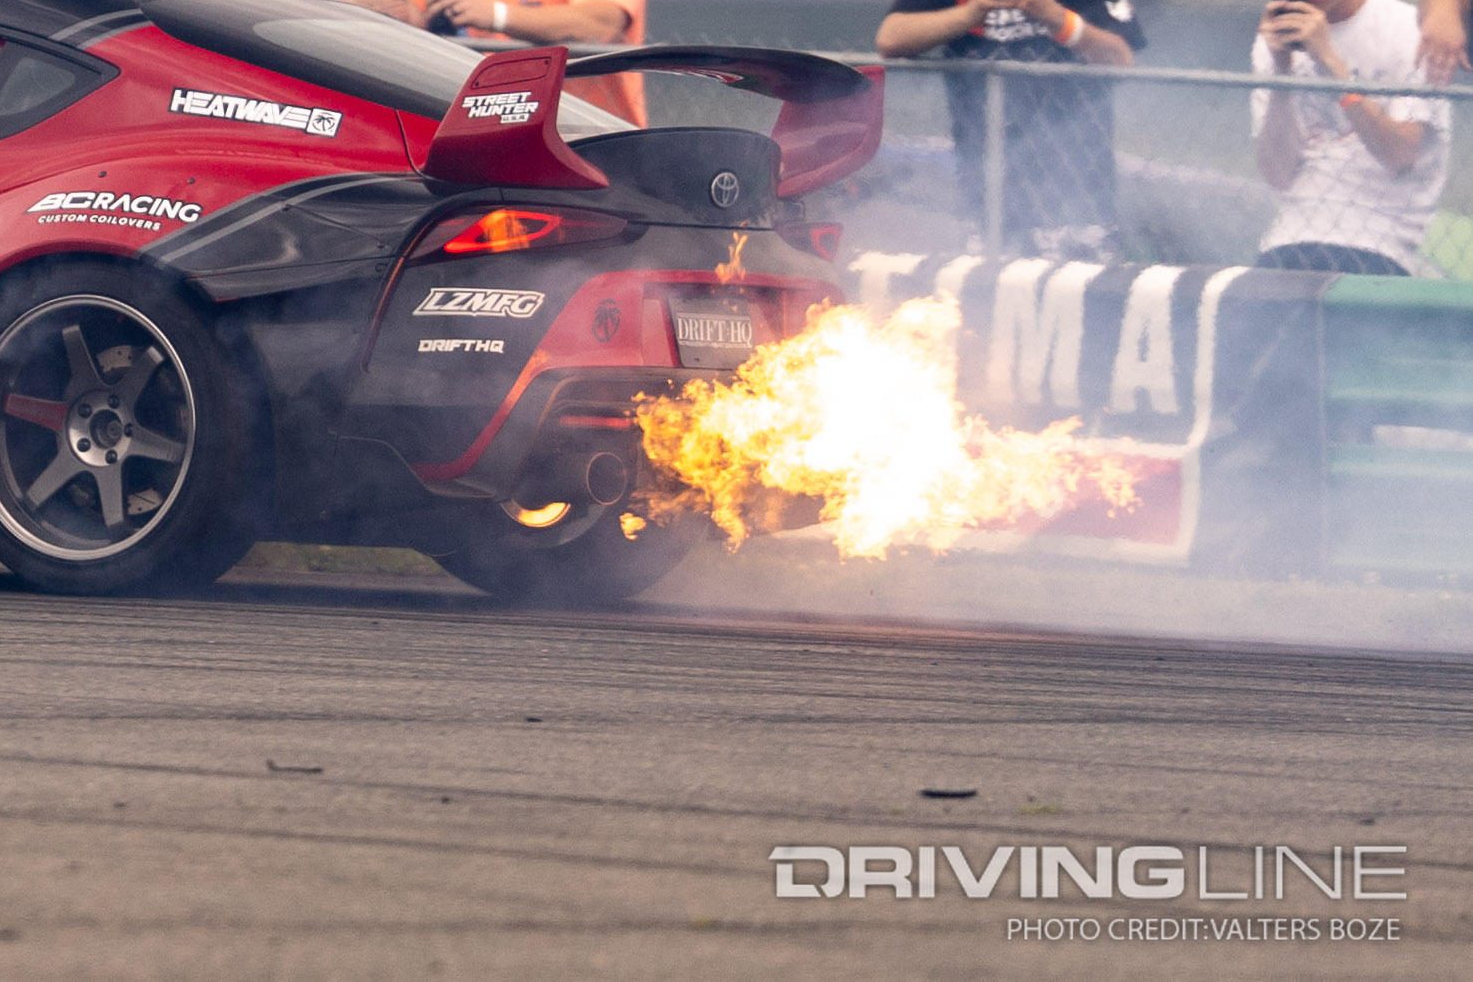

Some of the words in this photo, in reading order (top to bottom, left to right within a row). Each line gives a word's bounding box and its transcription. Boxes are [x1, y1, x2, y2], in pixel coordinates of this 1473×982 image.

[462, 91, 532, 108] STREET
[170, 89, 311, 130] HEATWAVE
[468, 101, 539, 118] HUNTER
[38, 214, 87, 224] CUSTOM
[89, 215, 161, 231] COILOVERS
[423, 292, 537, 315] LZMFG
[677, 318, 726, 342] DRIFT
[730, 320, 752, 348] HQ
[418, 340, 505, 353] DRIFTHQ
